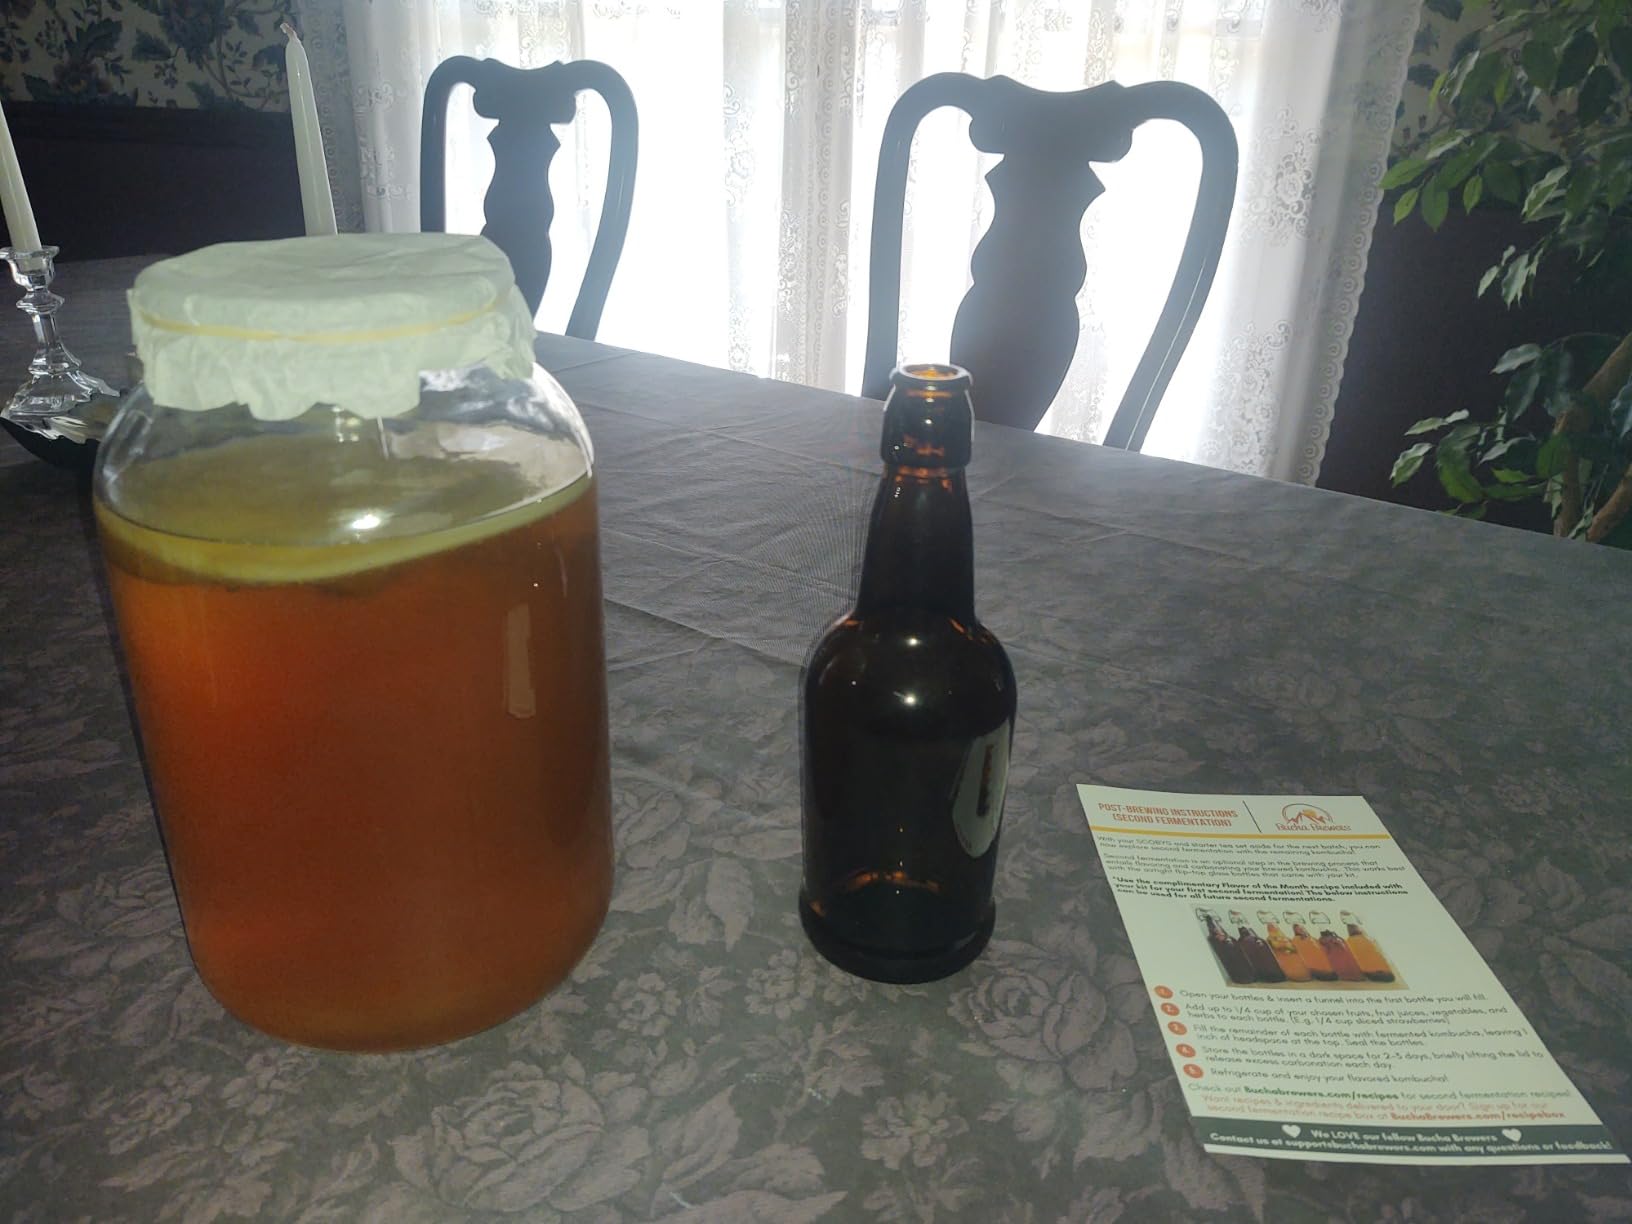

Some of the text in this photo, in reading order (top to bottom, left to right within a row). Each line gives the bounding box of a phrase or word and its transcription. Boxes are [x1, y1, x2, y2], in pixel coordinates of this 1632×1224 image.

[1098, 803, 1239, 818] POST-BREWING INSTRUCTIONS
[1209, 1132, 1254, 1144] Contact
[1271, 1138, 1283, 1146] at
[1437, 1144, 1463, 1152] with
[1310, 1129, 1330, 1139] We
[1332, 1131, 1360, 1140] LOVE
